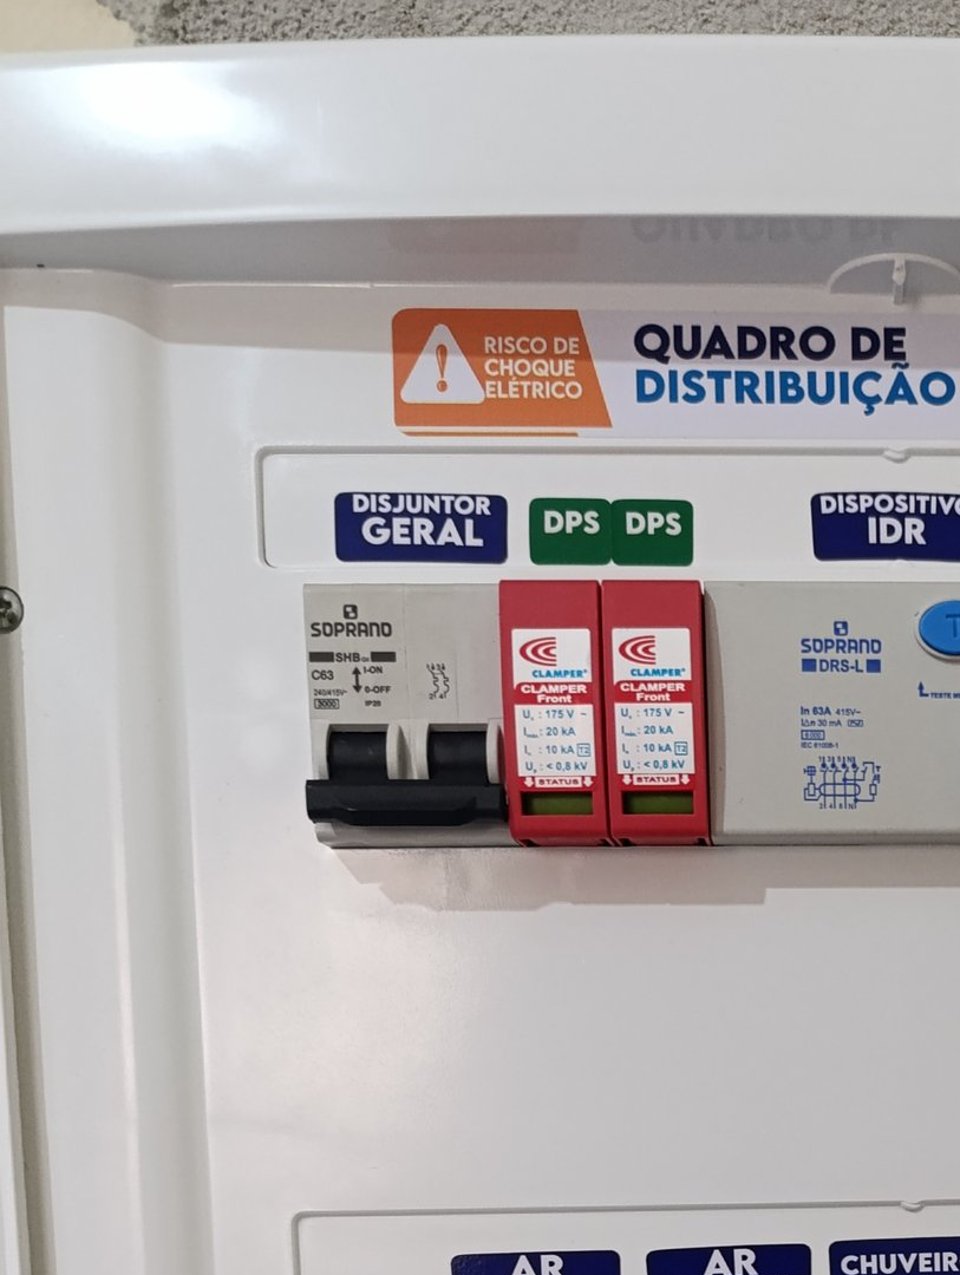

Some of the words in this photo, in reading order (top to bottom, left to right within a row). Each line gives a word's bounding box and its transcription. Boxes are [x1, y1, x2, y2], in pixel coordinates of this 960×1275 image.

[484, 337, 548, 355] RISCO
[554, 338, 580, 355] DE
[634, 324, 837, 363] QUADRO
[851, 326, 907, 361] DE
[484, 359, 576, 378] CHOQUE
[484, 377, 583, 400] ELÉTRICO
[635, 363, 956, 415] DISTRIBUIÇÃO
[352, 494, 491, 516] DISJUNTOR
[543, 510, 600, 534] DPS
[625, 511, 682, 536] DPS
[361, 517, 484, 547] GERAL
[867, 517, 927, 545] IDR
[311, 622, 392, 637] SOPRANO
[800, 638, 882, 654] SOPRANO
[819, 659, 864, 673] DRS-L
[312, 670, 334, 680] C63
[521, 684, 587, 694] CLAMPER
[620, 683, 685, 692] CLAMPER
[537, 694, 572, 704] Front
[636, 692, 671, 702] Front
[930, 691, 952, 699] TESTE
[545, 709, 564, 719] 175
[566, 709, 575, 719] V
[643, 708, 662, 717] 175
[663, 708, 673, 717] V
[812, 705, 832, 716] 63A
[546, 727, 559, 737] 20
[561, 727, 576, 737] kA
[643, 725, 656, 735] 20
[659, 725, 673, 735] kA
[546, 745, 559, 755] 10
[560, 745, 575, 755] kA
[643, 743, 656, 753] 10
[658, 743, 672, 752] kA
[574, 762, 588, 771] kV
[671, 760, 685, 769] kV
[538, 777, 580, 786] STATUS
[636, 776, 677, 784] STATUS
